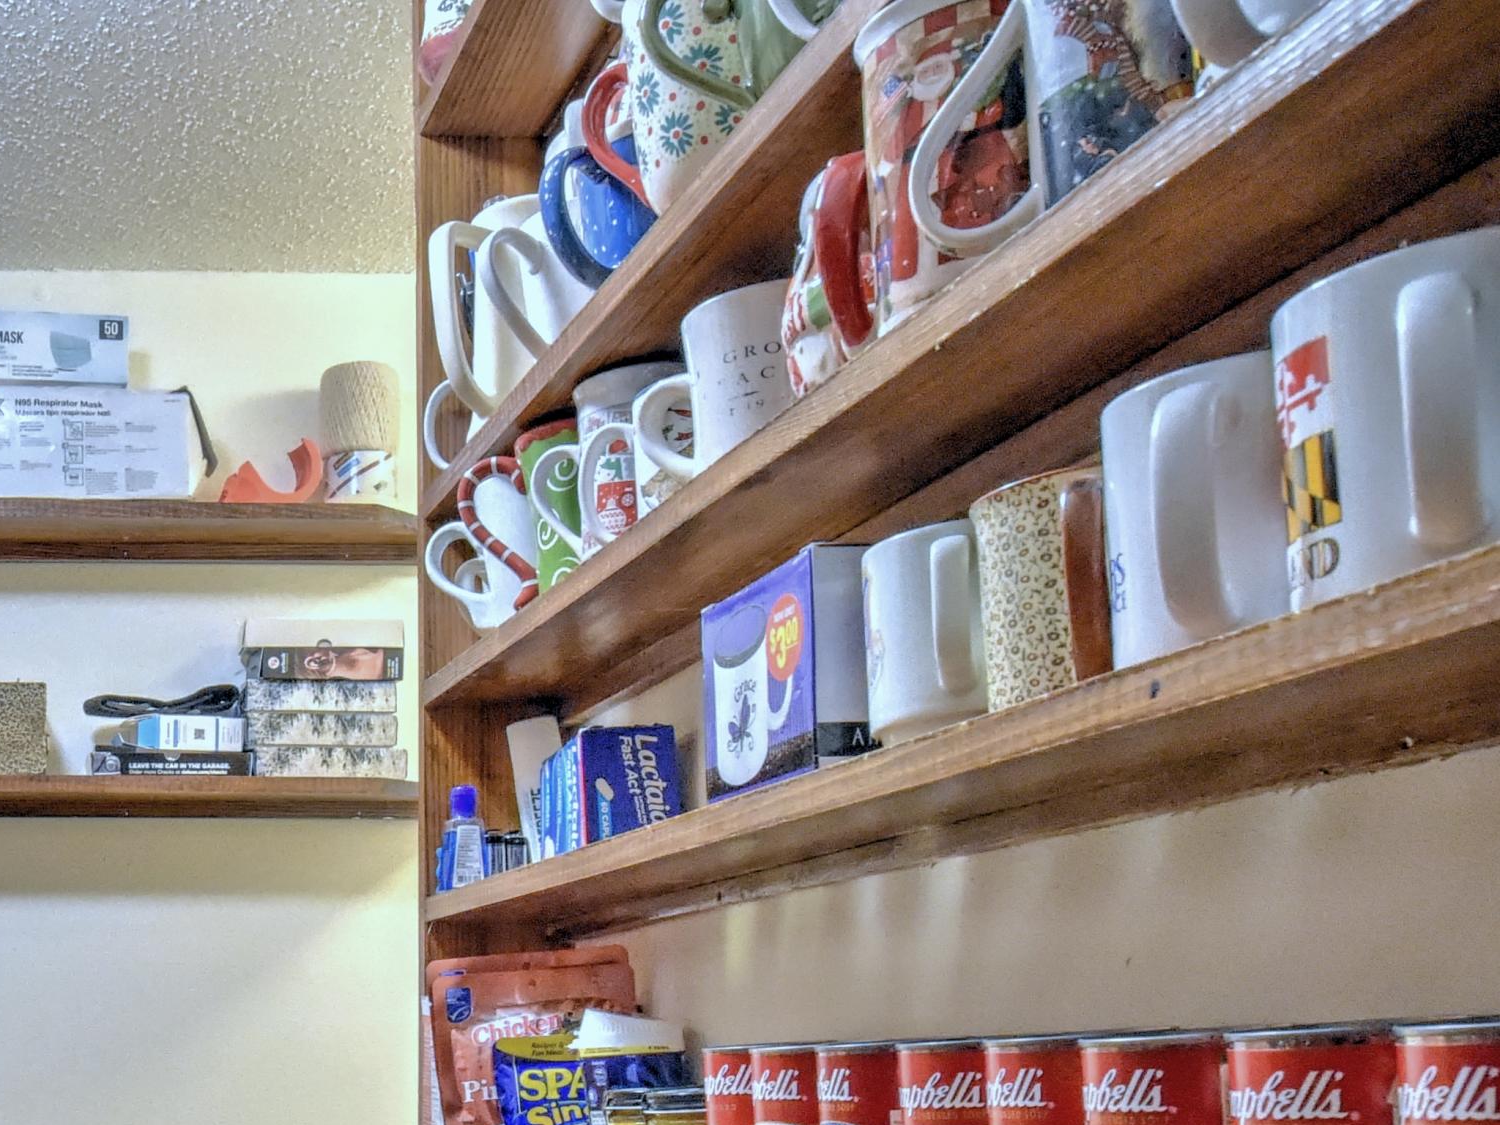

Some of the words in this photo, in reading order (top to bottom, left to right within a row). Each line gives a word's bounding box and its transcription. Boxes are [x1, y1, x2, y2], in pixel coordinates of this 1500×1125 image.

[104, 321, 119, 335] 50
[33, 398, 78, 409] Respirator
[471, 1012, 563, 1047] Chicken
[901, 1071, 987, 1117] mpbell's
